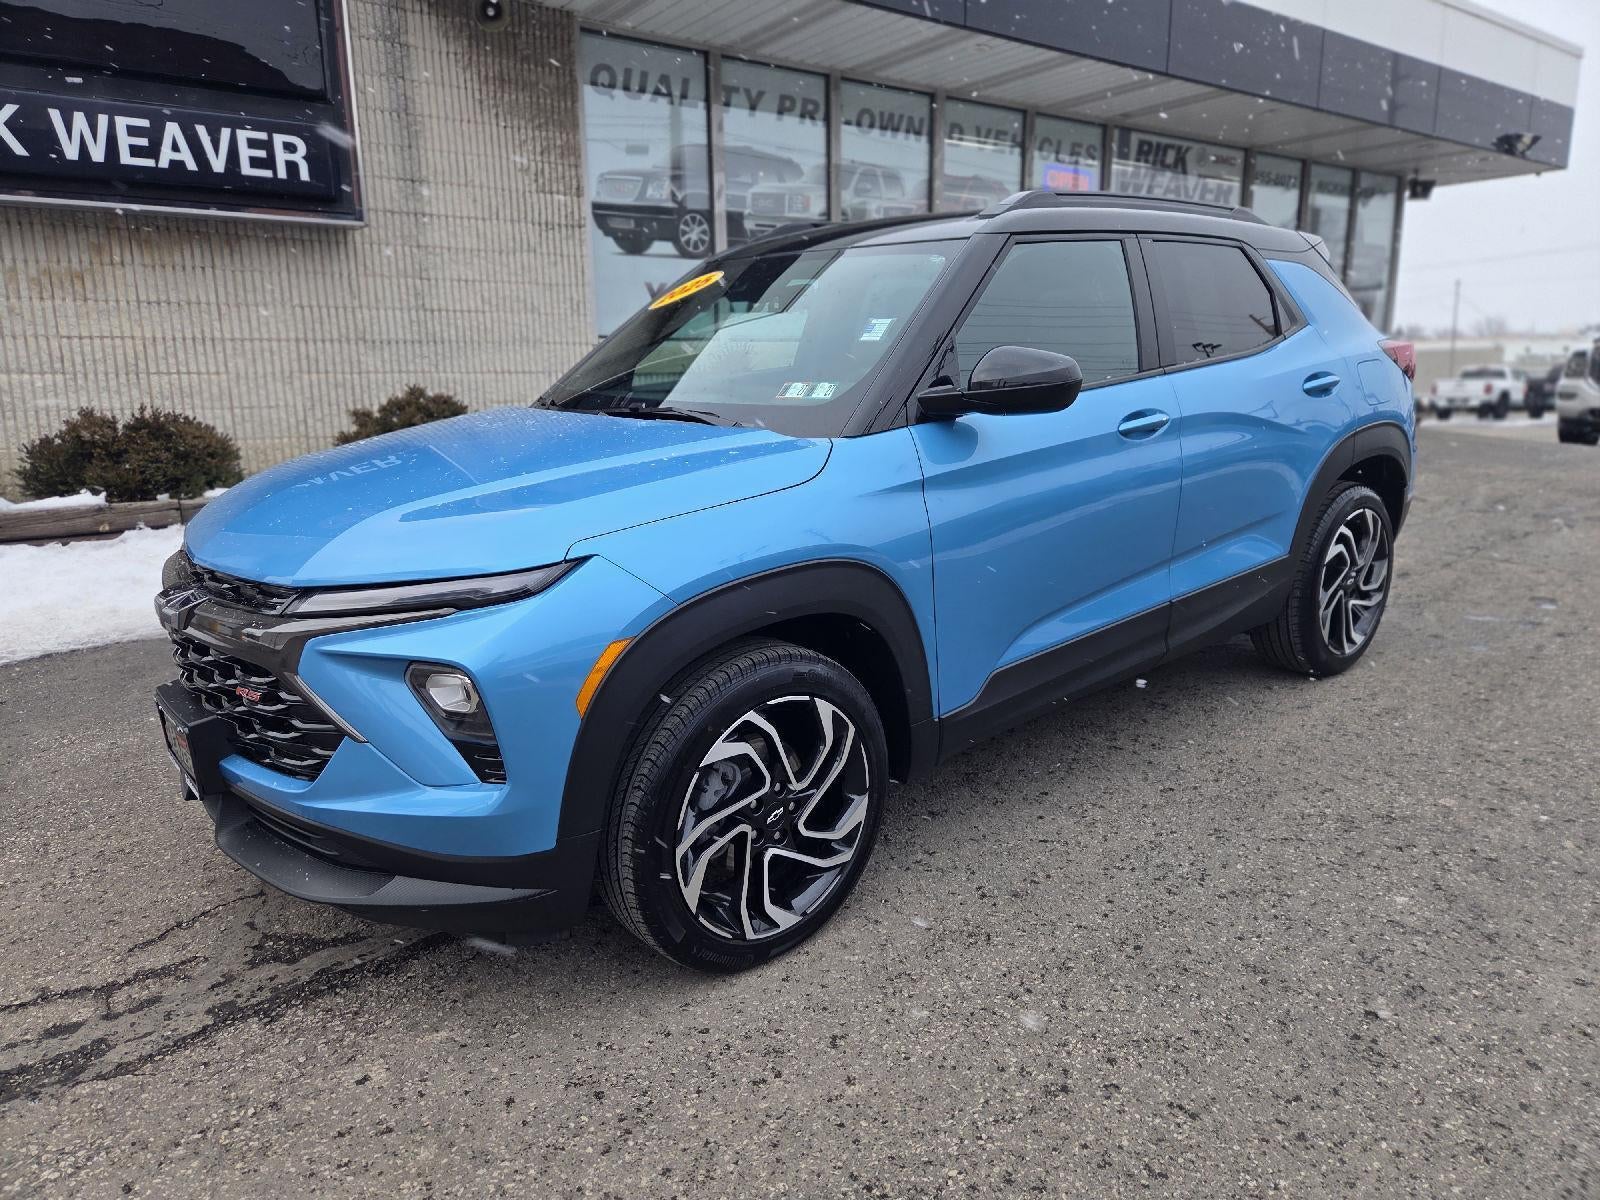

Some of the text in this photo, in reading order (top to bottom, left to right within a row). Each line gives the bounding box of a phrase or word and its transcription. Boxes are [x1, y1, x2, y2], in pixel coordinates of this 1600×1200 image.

[0, 103, 310, 182] K WEAVER
[589, 63, 1098, 170] QUALTY PR-OWND VEHCLES
[1116, 166, 1234, 204] WEAVER
[1134, 139, 1193, 175] RICK
